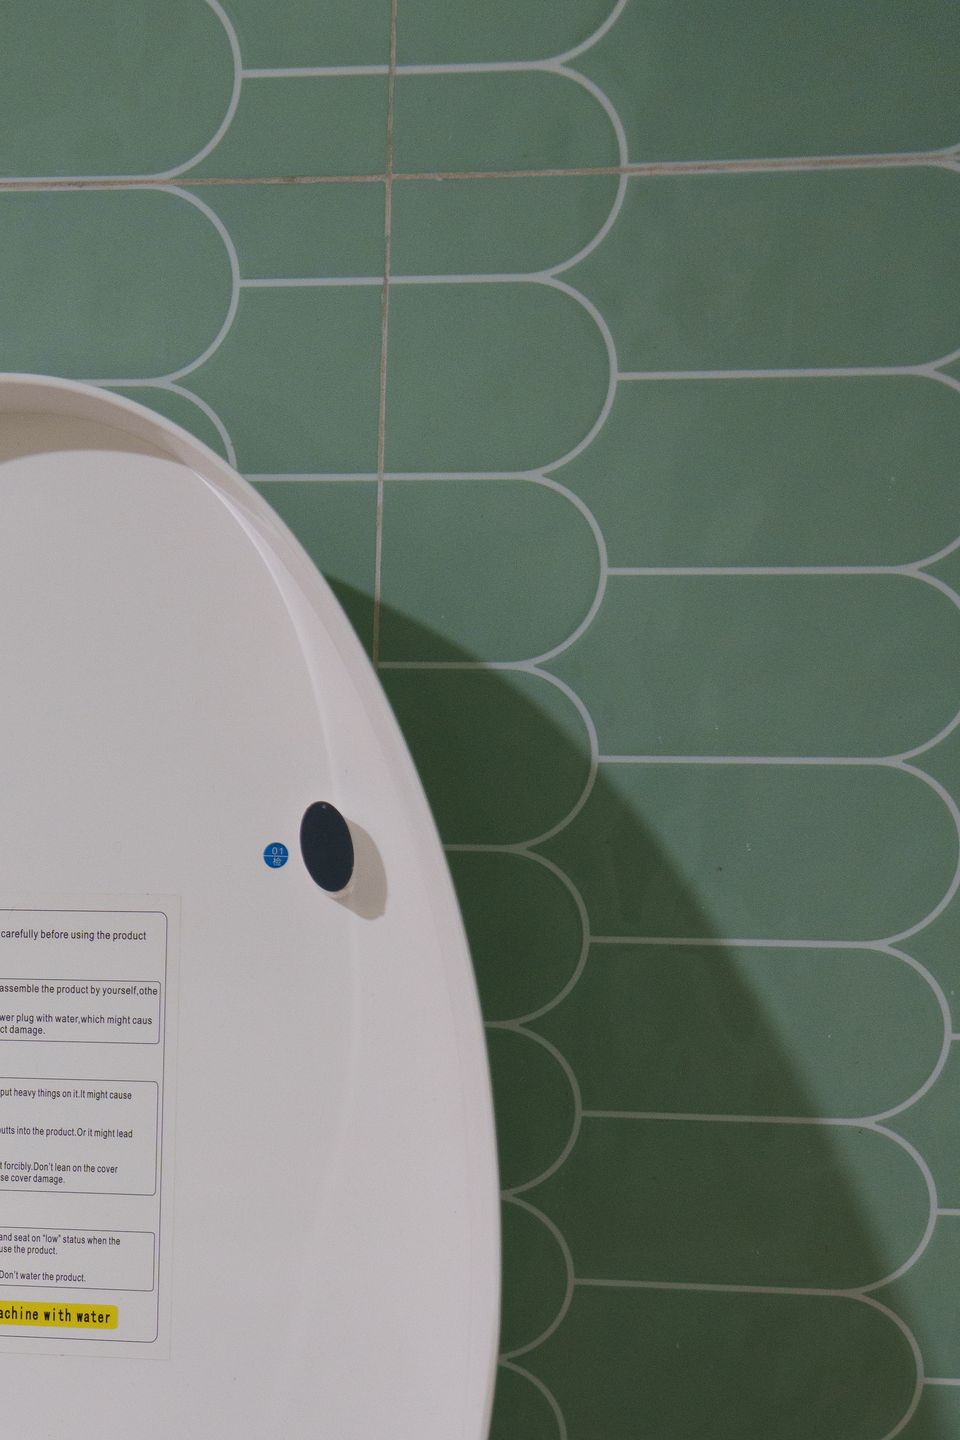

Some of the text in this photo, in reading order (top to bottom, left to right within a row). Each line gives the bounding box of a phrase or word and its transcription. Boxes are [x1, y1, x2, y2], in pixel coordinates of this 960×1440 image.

[0, 929, 38, 941] carefully
[40, 930, 69, 939] before
[70, 930, 95, 942] using
[97, 930, 111, 940] the
[112, 931, 147, 942] product
[41, 984, 55, 994] the
[56, 985, 89, 996] product
[90, 985, 100, 997] by
[16, 1013, 34, 1024] plug
[35, 1013, 53, 1023] with
[107, 1015, 131, 1026] might
[132, 1017, 153, 1025] caus
[9, 1025, 46, 1036] damage.
[0, 1087, 12, 1099] put
[14, 1088, 36, 1100] heavy
[37, 1088, 61, 1100] things
[87, 1090, 108, 1101] might
[109, 1092, 132, 1100] cause
[16, 1126, 31, 1135] into
[32, 1126, 45, 1136] the
[87, 1128, 93, 1137] it
[94, 1128, 115, 1140] might
[116, 1129, 133, 1138] lead
[54, 1163, 71, 1172] lean
[72, 1165, 82, 1173] on
[83, 1163, 96, 1173] the
[97, 1166, 118, 1174] cover
[10, 1174, 32, 1182] cover
[33, 1173, 66, 1185] damage.
[13, 1233, 30, 1243] seat
[31, 1235, 41, 1243] on
[62, 1234, 86, 1244] status
[87, 1235, 107, 1245] when
[108, 1236, 121, 1246] the
[0, 1246, 12, 1254] use
[13, 1244, 25, 1254] the
[27, 1245, 58, 1256] product.
[20, 1271, 41, 1281] water
[42, 1272, 54, 1281] the
[55, 1272, 86, 1283] product.
[43, 1308, 71, 1322] with
[77, 1309, 111, 1323] water
